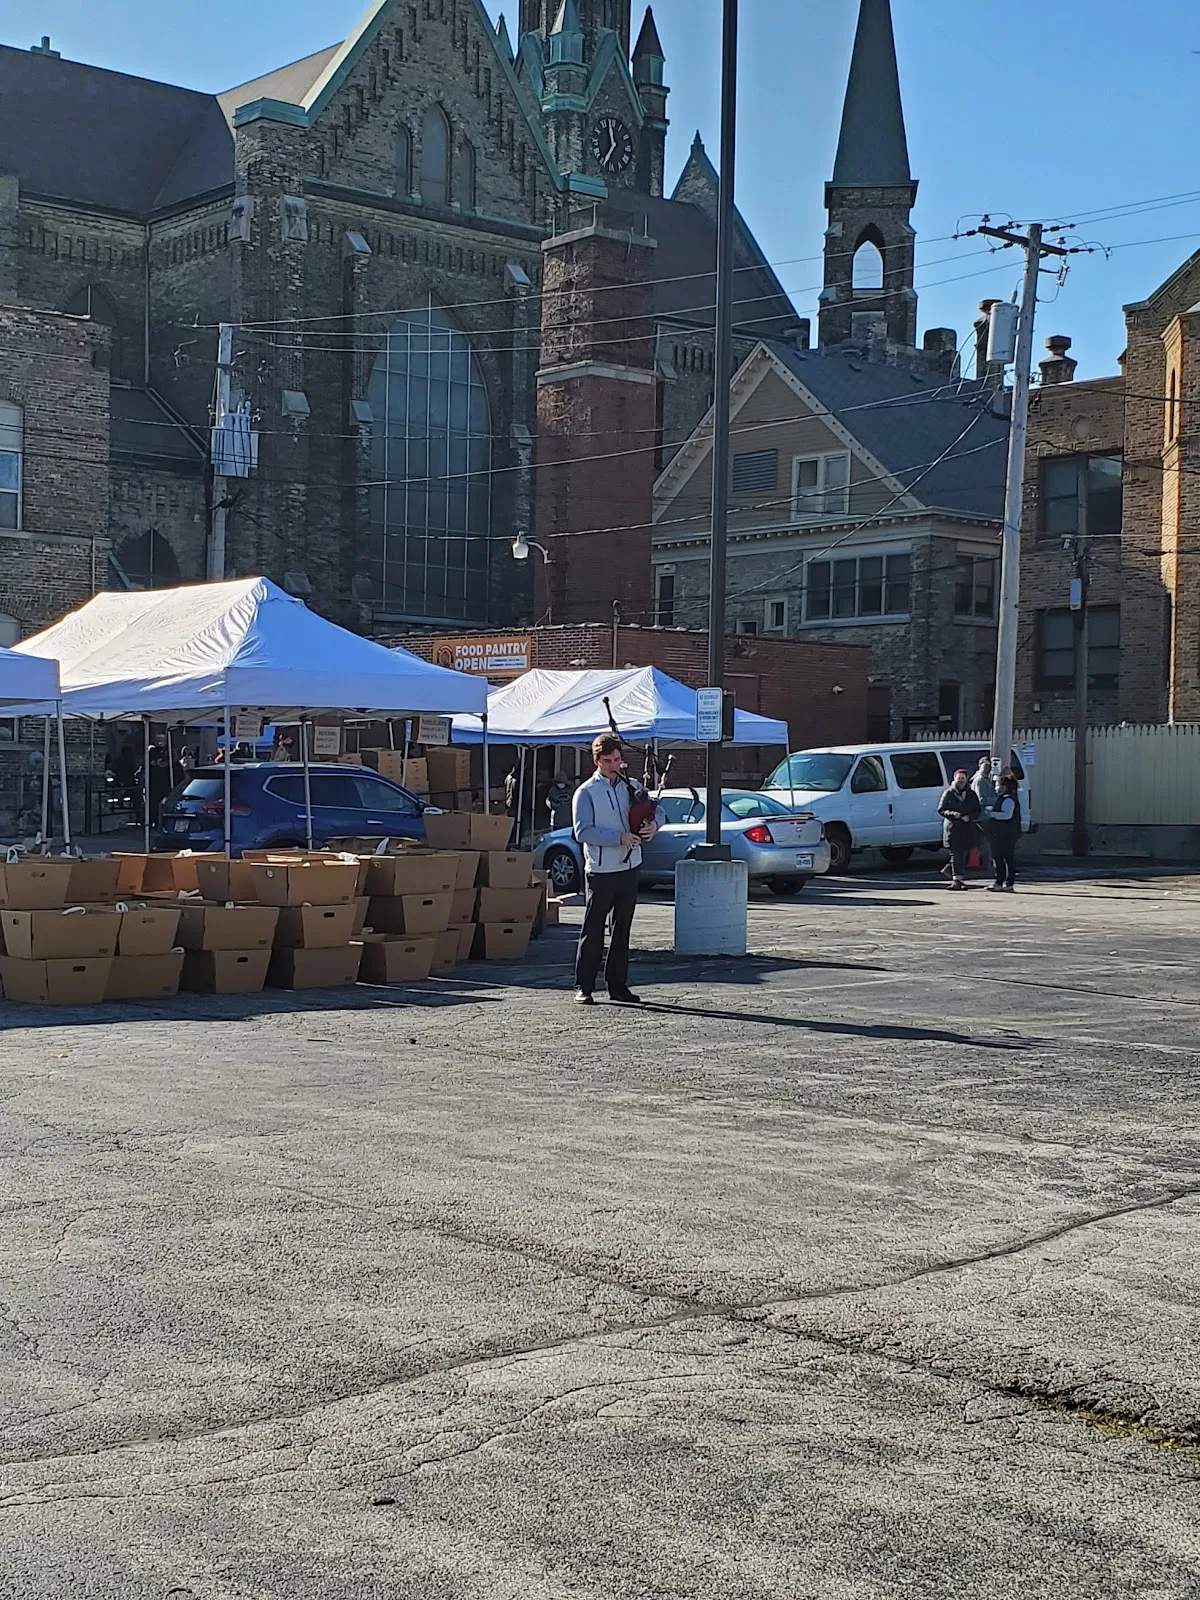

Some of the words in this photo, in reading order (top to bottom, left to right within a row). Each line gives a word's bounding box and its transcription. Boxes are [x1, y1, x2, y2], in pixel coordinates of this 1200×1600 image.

[455, 645, 483, 656] FOOD
[486, 641, 528, 655] PANTRY
[455, 657, 488, 670] OPEN
